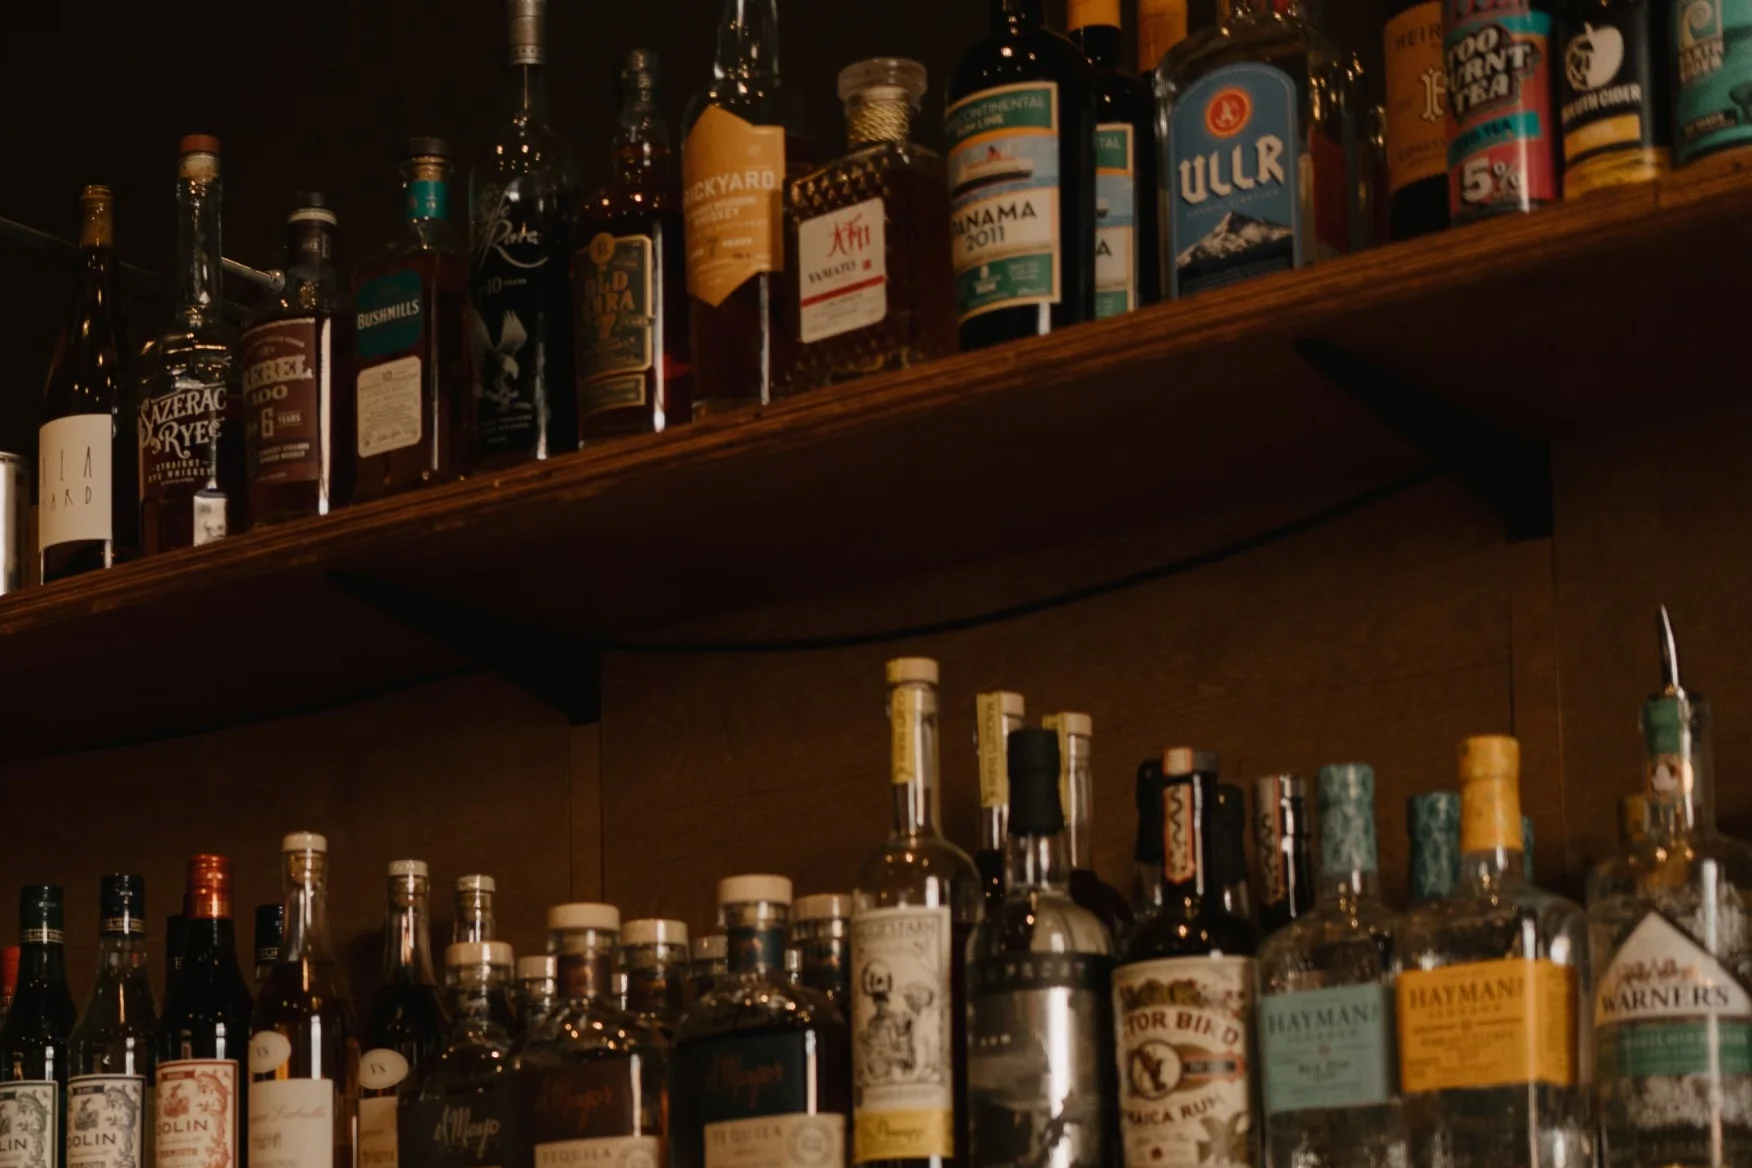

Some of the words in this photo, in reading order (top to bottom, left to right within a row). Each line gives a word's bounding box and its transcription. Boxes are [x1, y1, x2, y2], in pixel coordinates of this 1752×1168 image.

[1453, 73, 1510, 114] TEA
[1179, 133, 1285, 204] ULLR
[1462, 157, 1521, 202] 5%
[685, 169, 777, 204] RICKYARD
[965, 225, 1006, 251] 2011
[489, 276, 503, 295] 10
[808, 261, 857, 285] YAMATO
[357, 299, 420, 330] BUSHMILLS
[381, 371, 392, 382] 10
[140, 387, 227, 444] SAZERAC
[261, 407, 274, 439] 6
[151, 417, 225, 459] RYE
[156, 459, 200, 472] STRAIGHT
[1125, 1010, 1167, 1036] TOR
[1176, 1011, 1240, 1046] BIRD
[370, 1063, 386, 1075] VS
[711, 1126, 783, 1146] TEQUILA
[542, 1147, 613, 1166] TEQUILA
